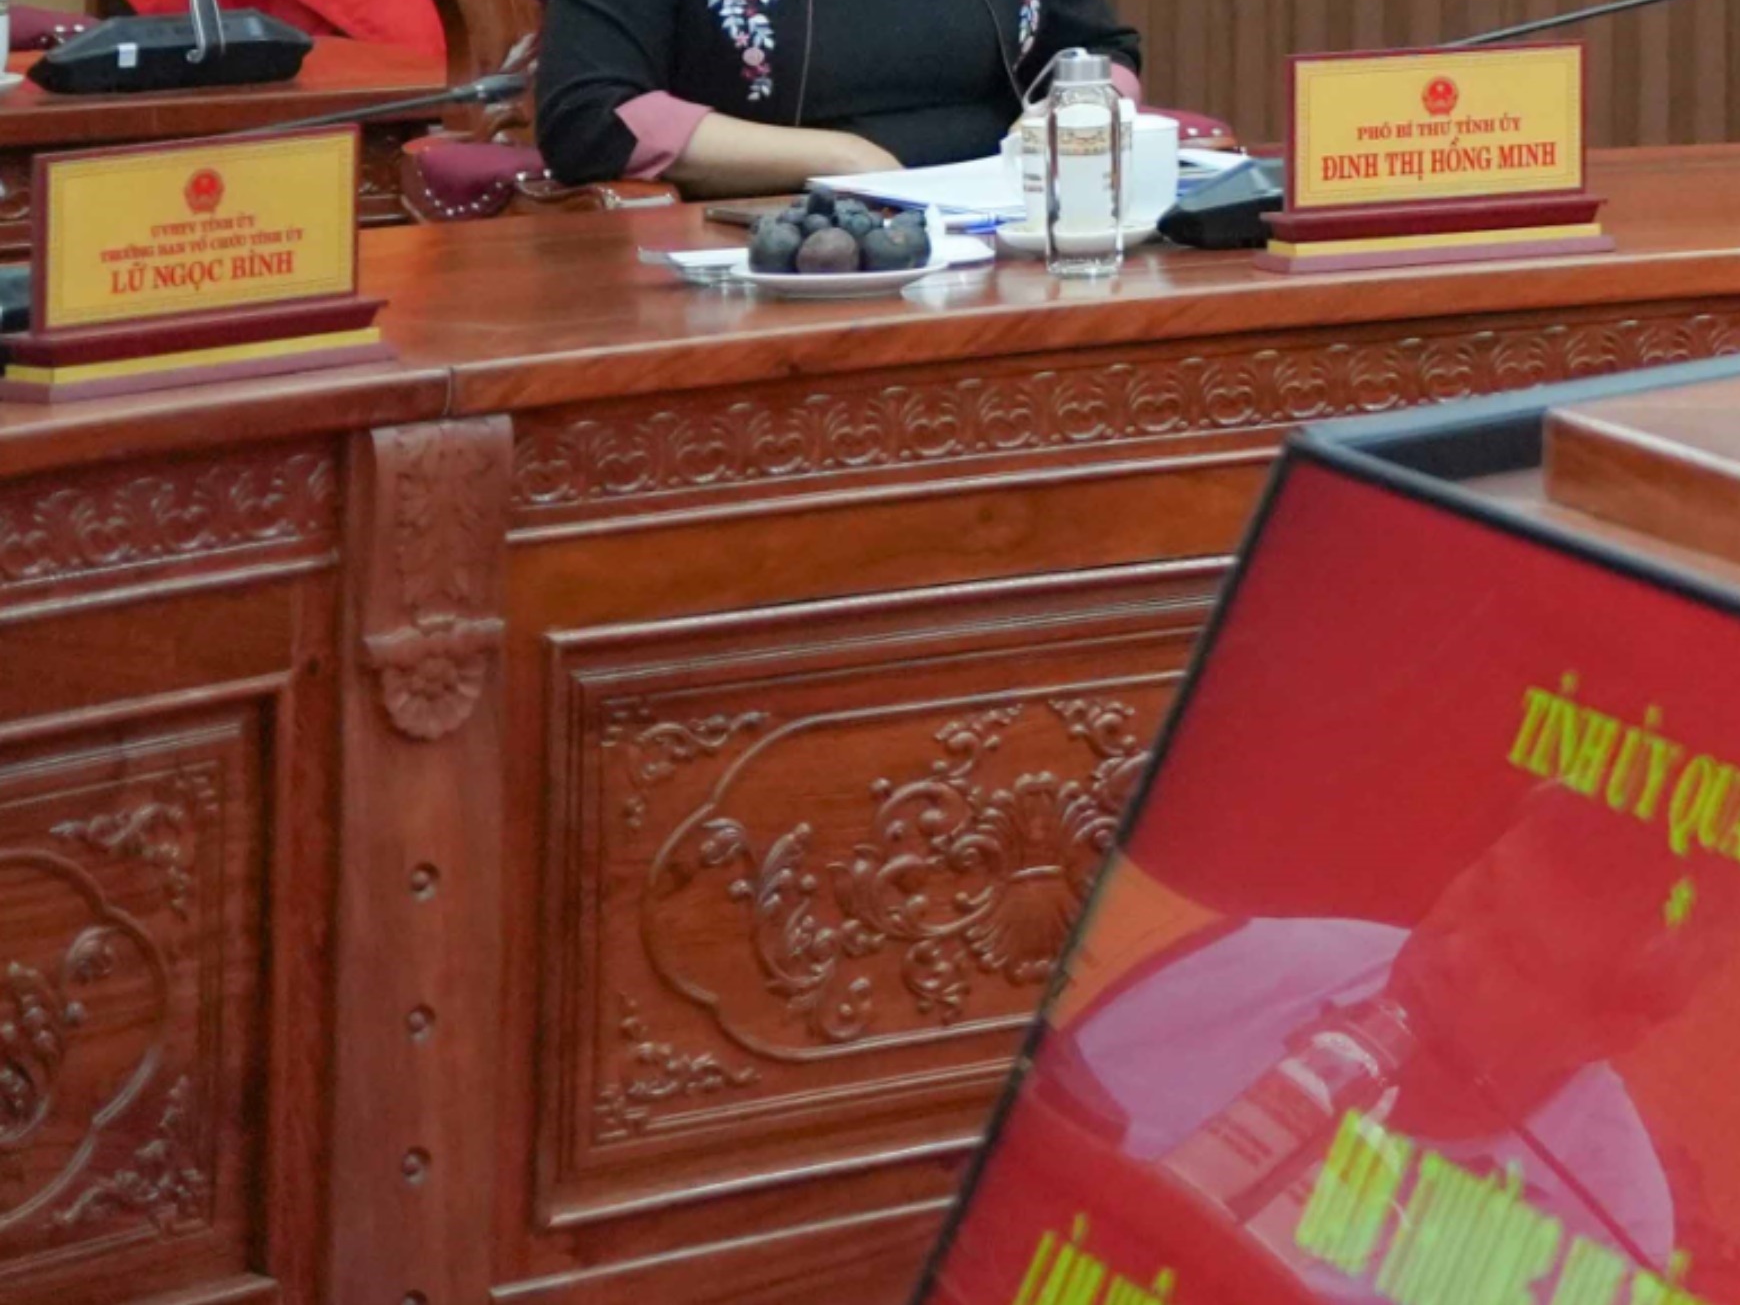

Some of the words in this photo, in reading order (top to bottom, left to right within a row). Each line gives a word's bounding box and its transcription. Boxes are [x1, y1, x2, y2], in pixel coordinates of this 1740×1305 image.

[1356, 122, 1392, 142] PHÓ
[1395, 120, 1413, 139] BÍ
[1417, 118, 1452, 138] THƯ
[1454, 115, 1495, 134] TỈNH
[1498, 112, 1521, 132] ỦY
[1321, 153, 1378, 182] ĐINH
[1386, 150, 1424, 181] THỊ
[1497, 142, 1557, 170] MINH
[152, 258, 223, 291] NGỌC
[230, 249, 294, 281] BÌNH
[1507, 670, 1620, 800] TỈNH
[1605, 703, 1684, 823] ỦY
